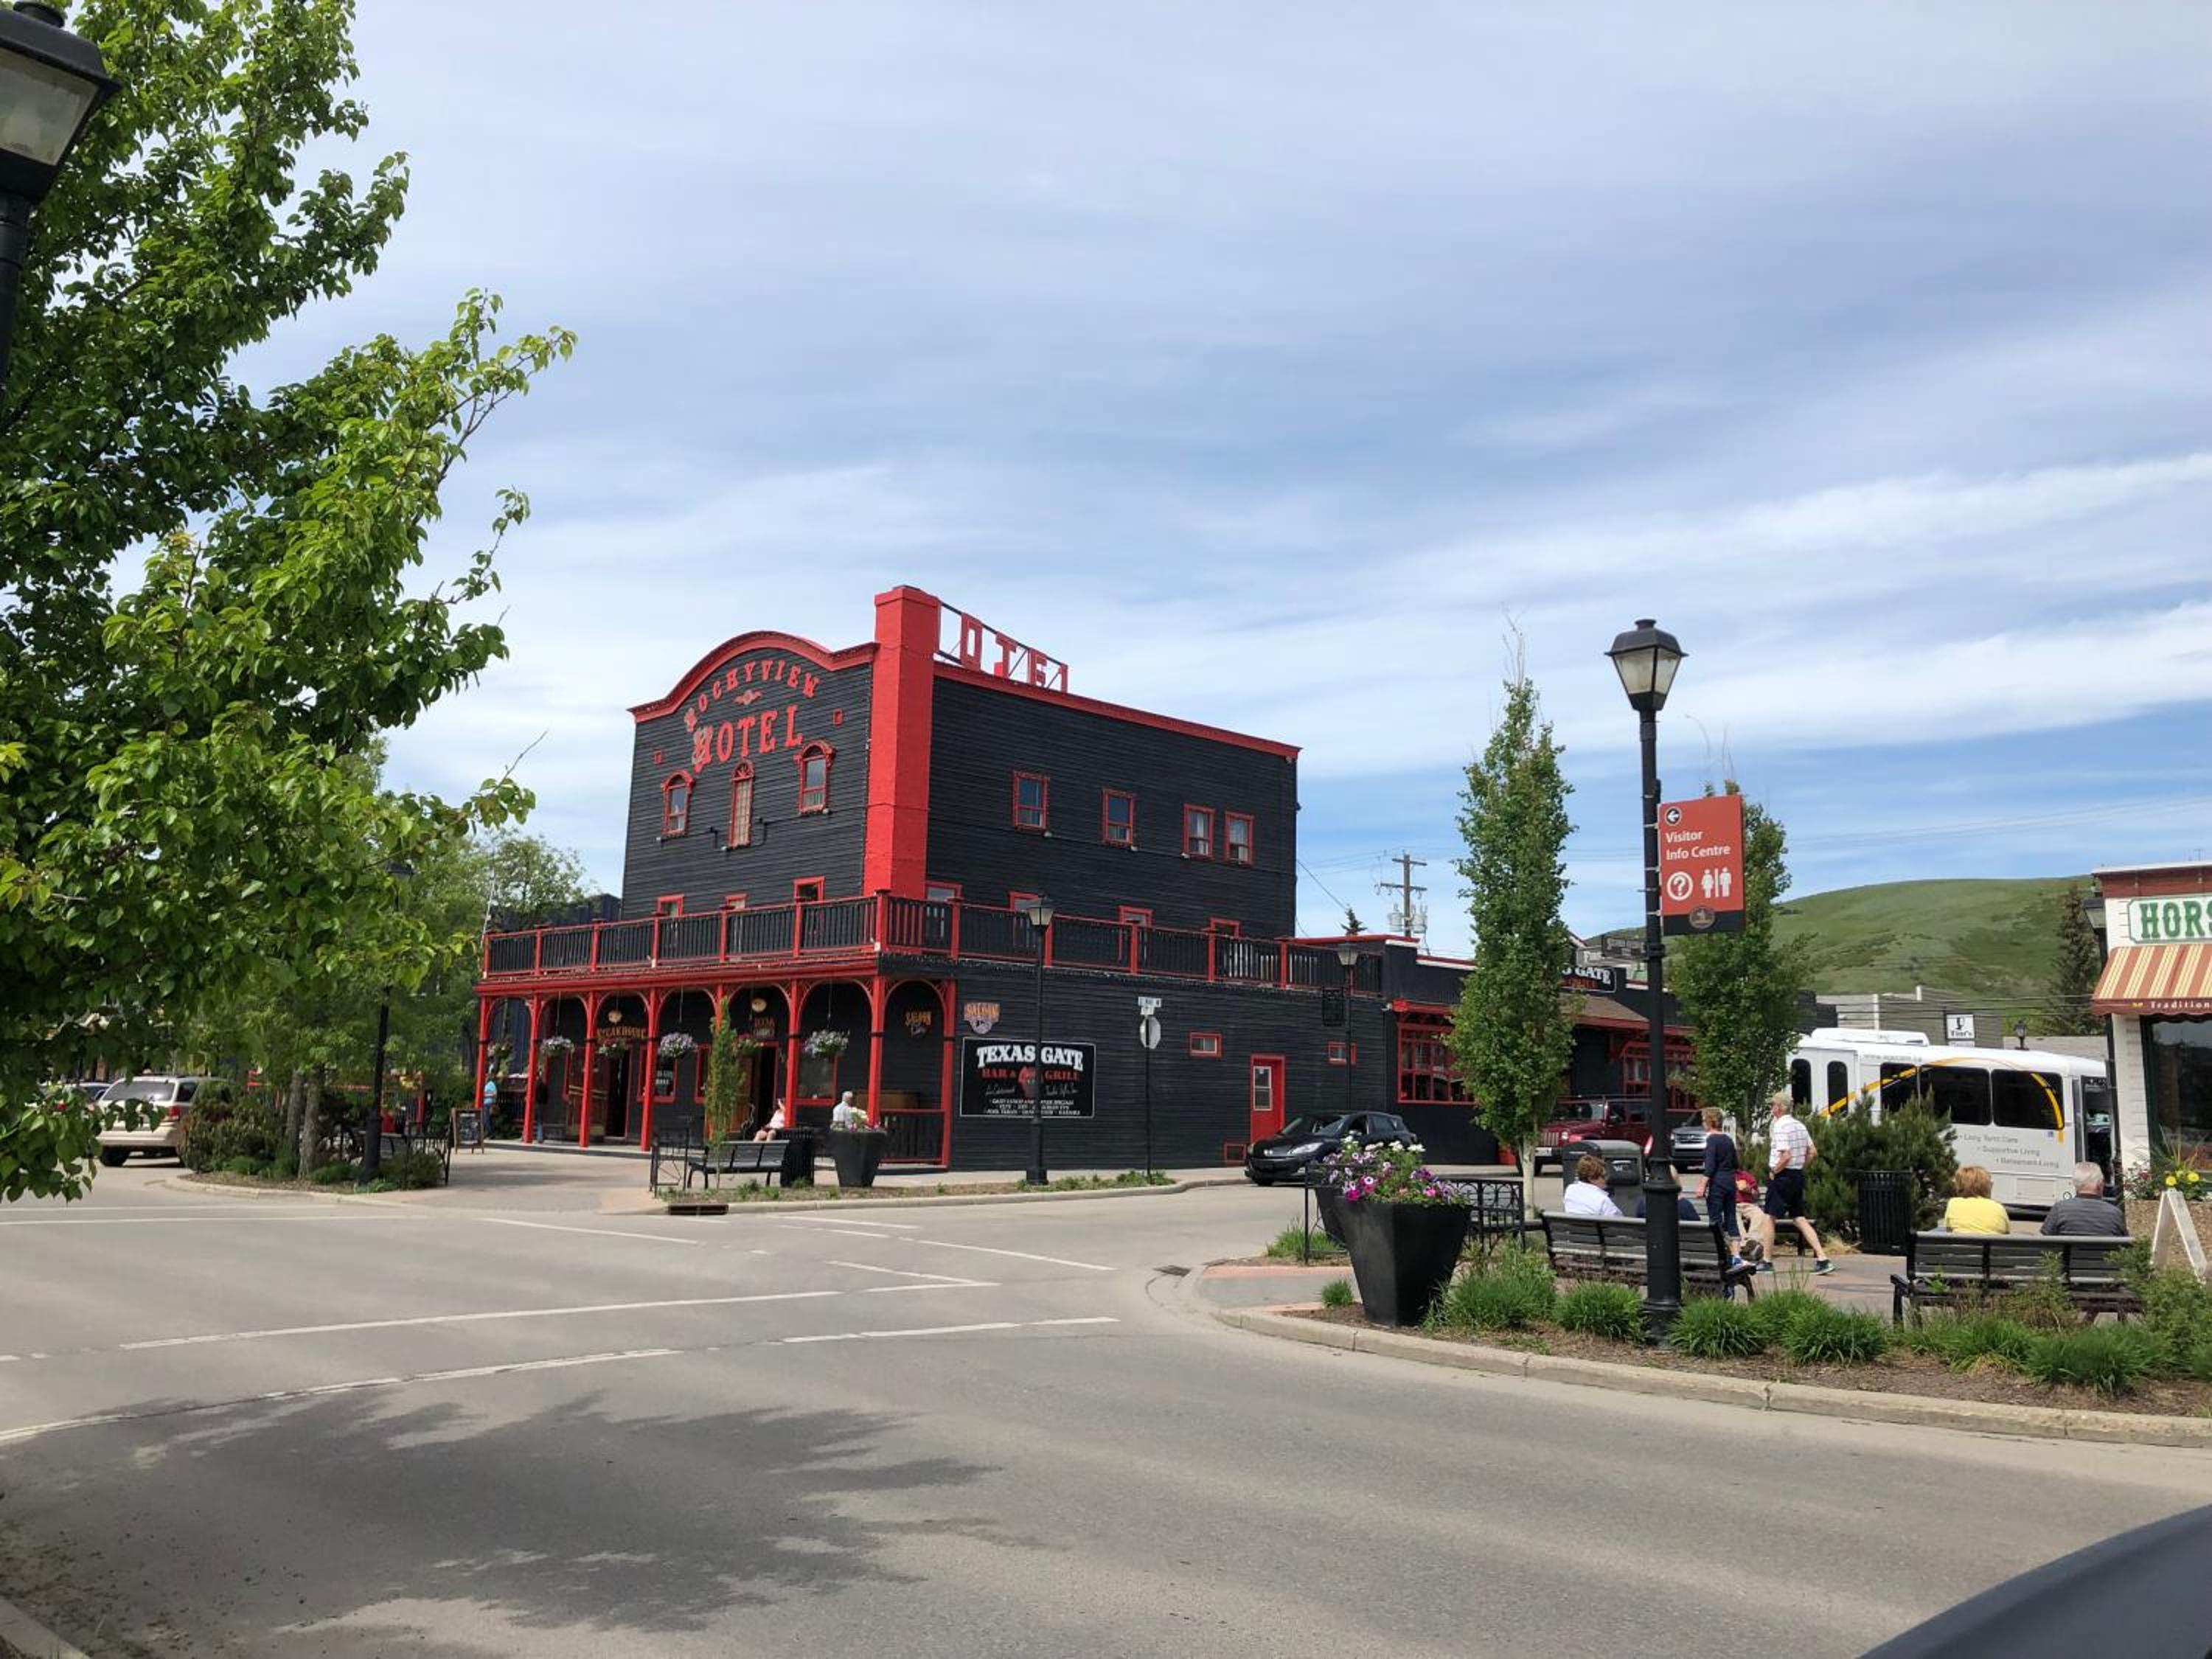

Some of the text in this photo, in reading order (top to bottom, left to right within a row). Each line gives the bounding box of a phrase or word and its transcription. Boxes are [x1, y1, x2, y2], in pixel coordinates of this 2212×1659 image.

[691, 704, 803, 773] HOTEL
[1665, 830, 1703, 844] Visitor
[1666, 845, 1731, 860] Info Centre
[977, 1044, 1083, 1071] TEXAS GATE
[982, 1068, 1007, 1079] BAR
